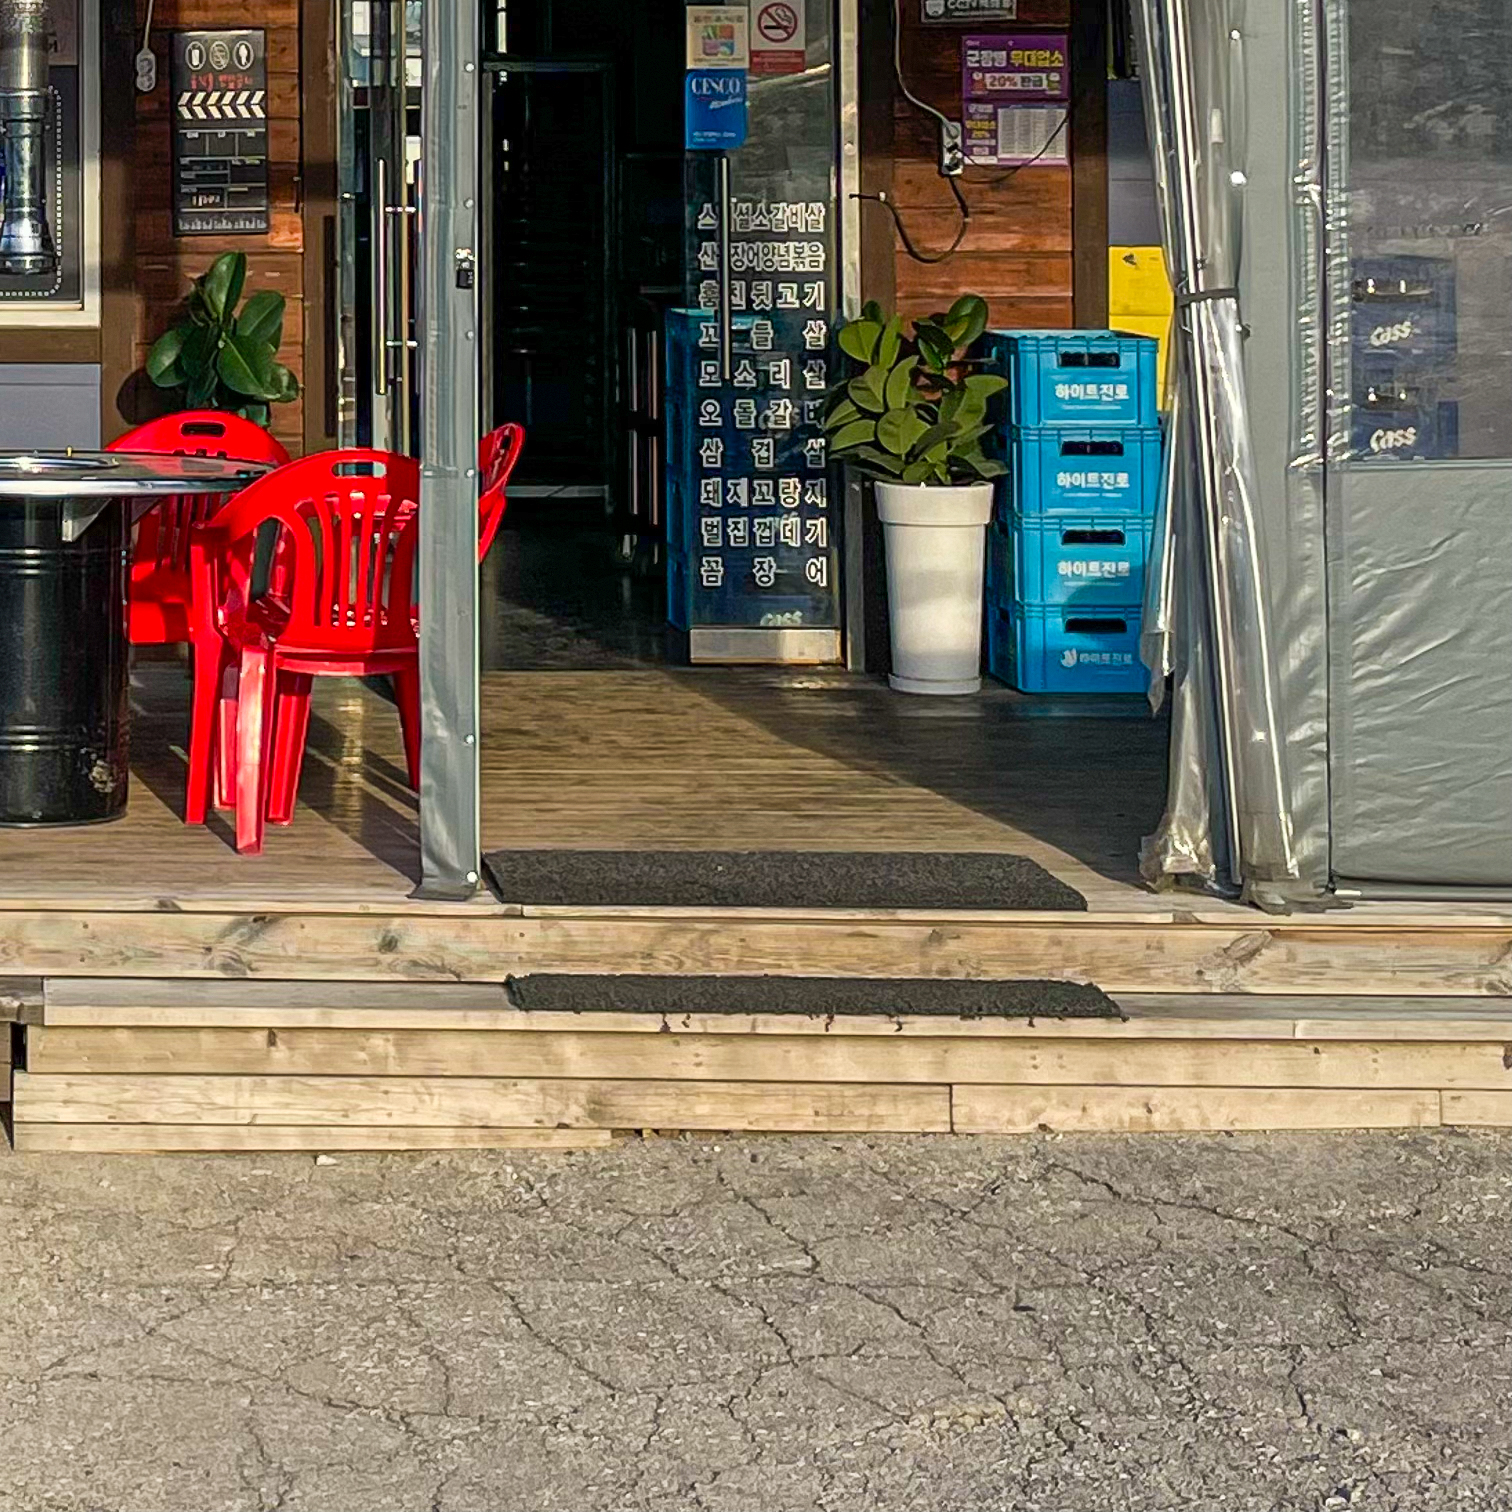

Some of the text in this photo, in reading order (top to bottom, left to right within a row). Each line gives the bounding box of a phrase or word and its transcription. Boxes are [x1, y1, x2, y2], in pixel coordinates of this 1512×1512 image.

[697, 241, 826, 272] 산장어양념볶음
[1054, 383, 1129, 400] 하이트진로
[700, 477, 827, 508] 돼지꼬랑지
[1057, 472, 1130, 489] 하이트진로
[701, 516, 827, 547] 벌집껍데기
[1057, 561, 1130, 578] 하이트진로
